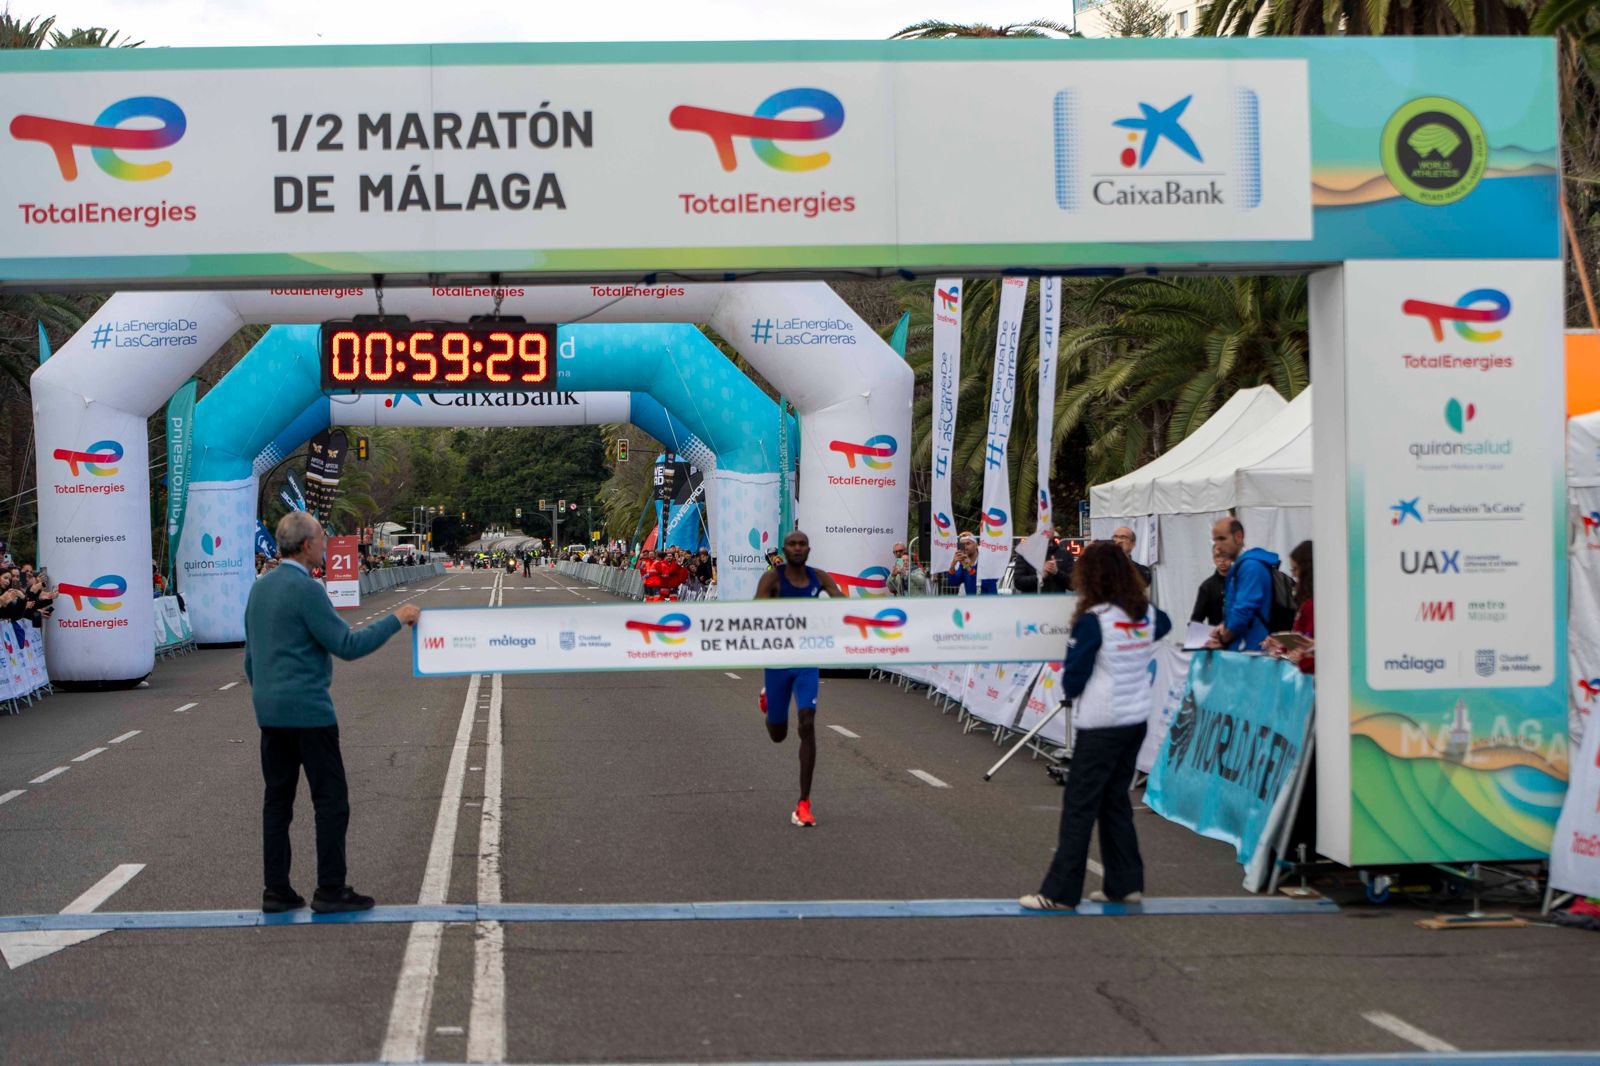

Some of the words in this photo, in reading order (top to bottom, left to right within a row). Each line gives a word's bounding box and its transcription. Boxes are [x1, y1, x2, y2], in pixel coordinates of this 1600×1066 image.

[271, 113, 344, 153] 1/2
[359, 101, 594, 151] MARATÓN
[273, 174, 335, 214] DE
[359, 164, 567, 212] MÁLAGA
[1093, 180, 1225, 206] CaixaBank
[679, 191, 856, 220] TotalEnergies
[18, 200, 197, 229] TotalEnergies
[430, 285, 525, 298] TotalEnergies
[590, 285, 685, 299] TotalEnergies
[115, 333, 198, 348] LasCarreras
[775, 331, 857, 346] LasCarreras
[331, 330, 548, 383] 00:59:29
[1401, 354, 1514, 371] TotalEnergies
[1408, 439, 1512, 459] quirónsalud
[54, 483, 125, 495] TotalEnergies
[827, 475, 897, 488] TotalEnergies
[825, 525, 894, 535] totalenergies.es
[55, 533, 127, 545] totalenergies.es
[184, 557, 243, 575] quirónsalud
[331, 554, 352, 570] 21
[1400, 549, 1460, 574] UAX
[1467, 601, 1505, 610] metro
[58, 617, 129, 630] TotalEnergies
[700, 618, 724, 633] 1/2
[729, 612, 807, 632] MARATÓN
[1039, 623, 1070, 636] Caixa
[701, 638, 721, 651] DE
[725, 633, 795, 650] MÁLAGA
[799, 636, 835, 649] 2026
[626, 649, 693, 660] TotalEnergies
[844, 645, 910, 656] TotalEnergies
